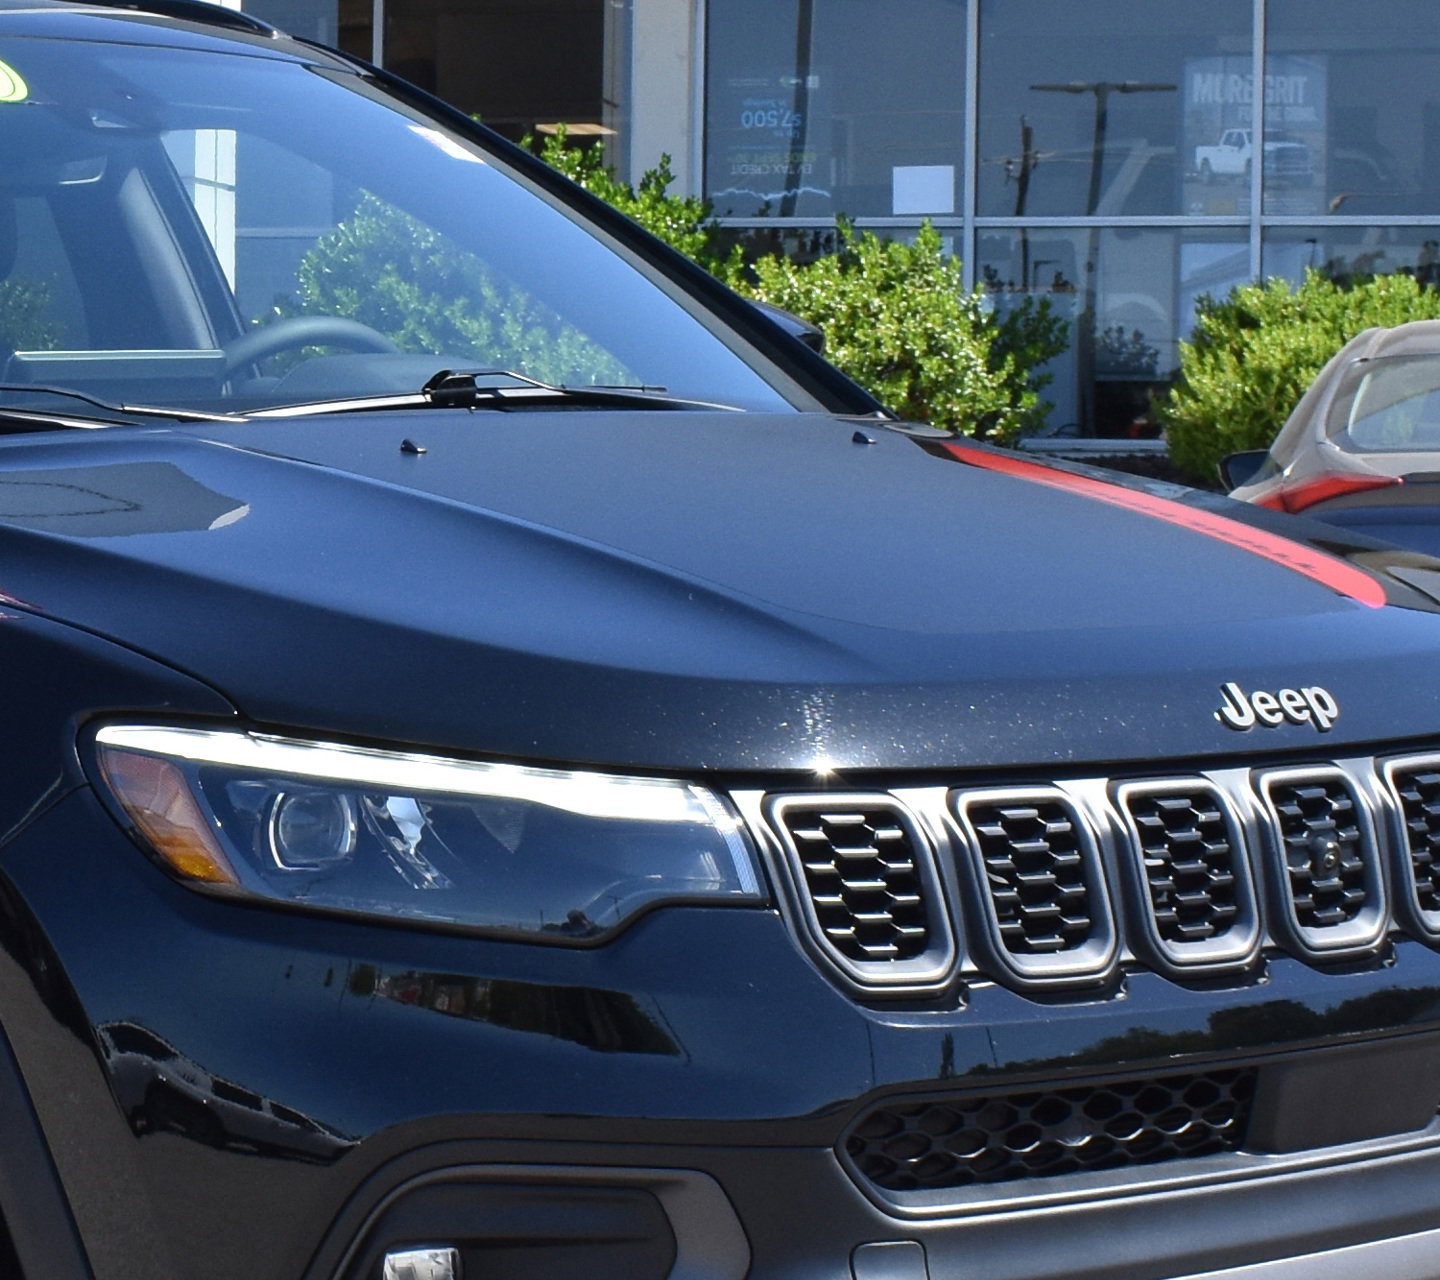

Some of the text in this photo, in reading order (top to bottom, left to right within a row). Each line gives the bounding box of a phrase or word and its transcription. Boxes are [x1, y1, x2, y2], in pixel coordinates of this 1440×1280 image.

[740, 108, 801, 128] $7,500
[730, 163, 770, 175] CREDIT
[773, 163, 797, 175] TAX
[1217, 682, 1339, 732] Jeep
